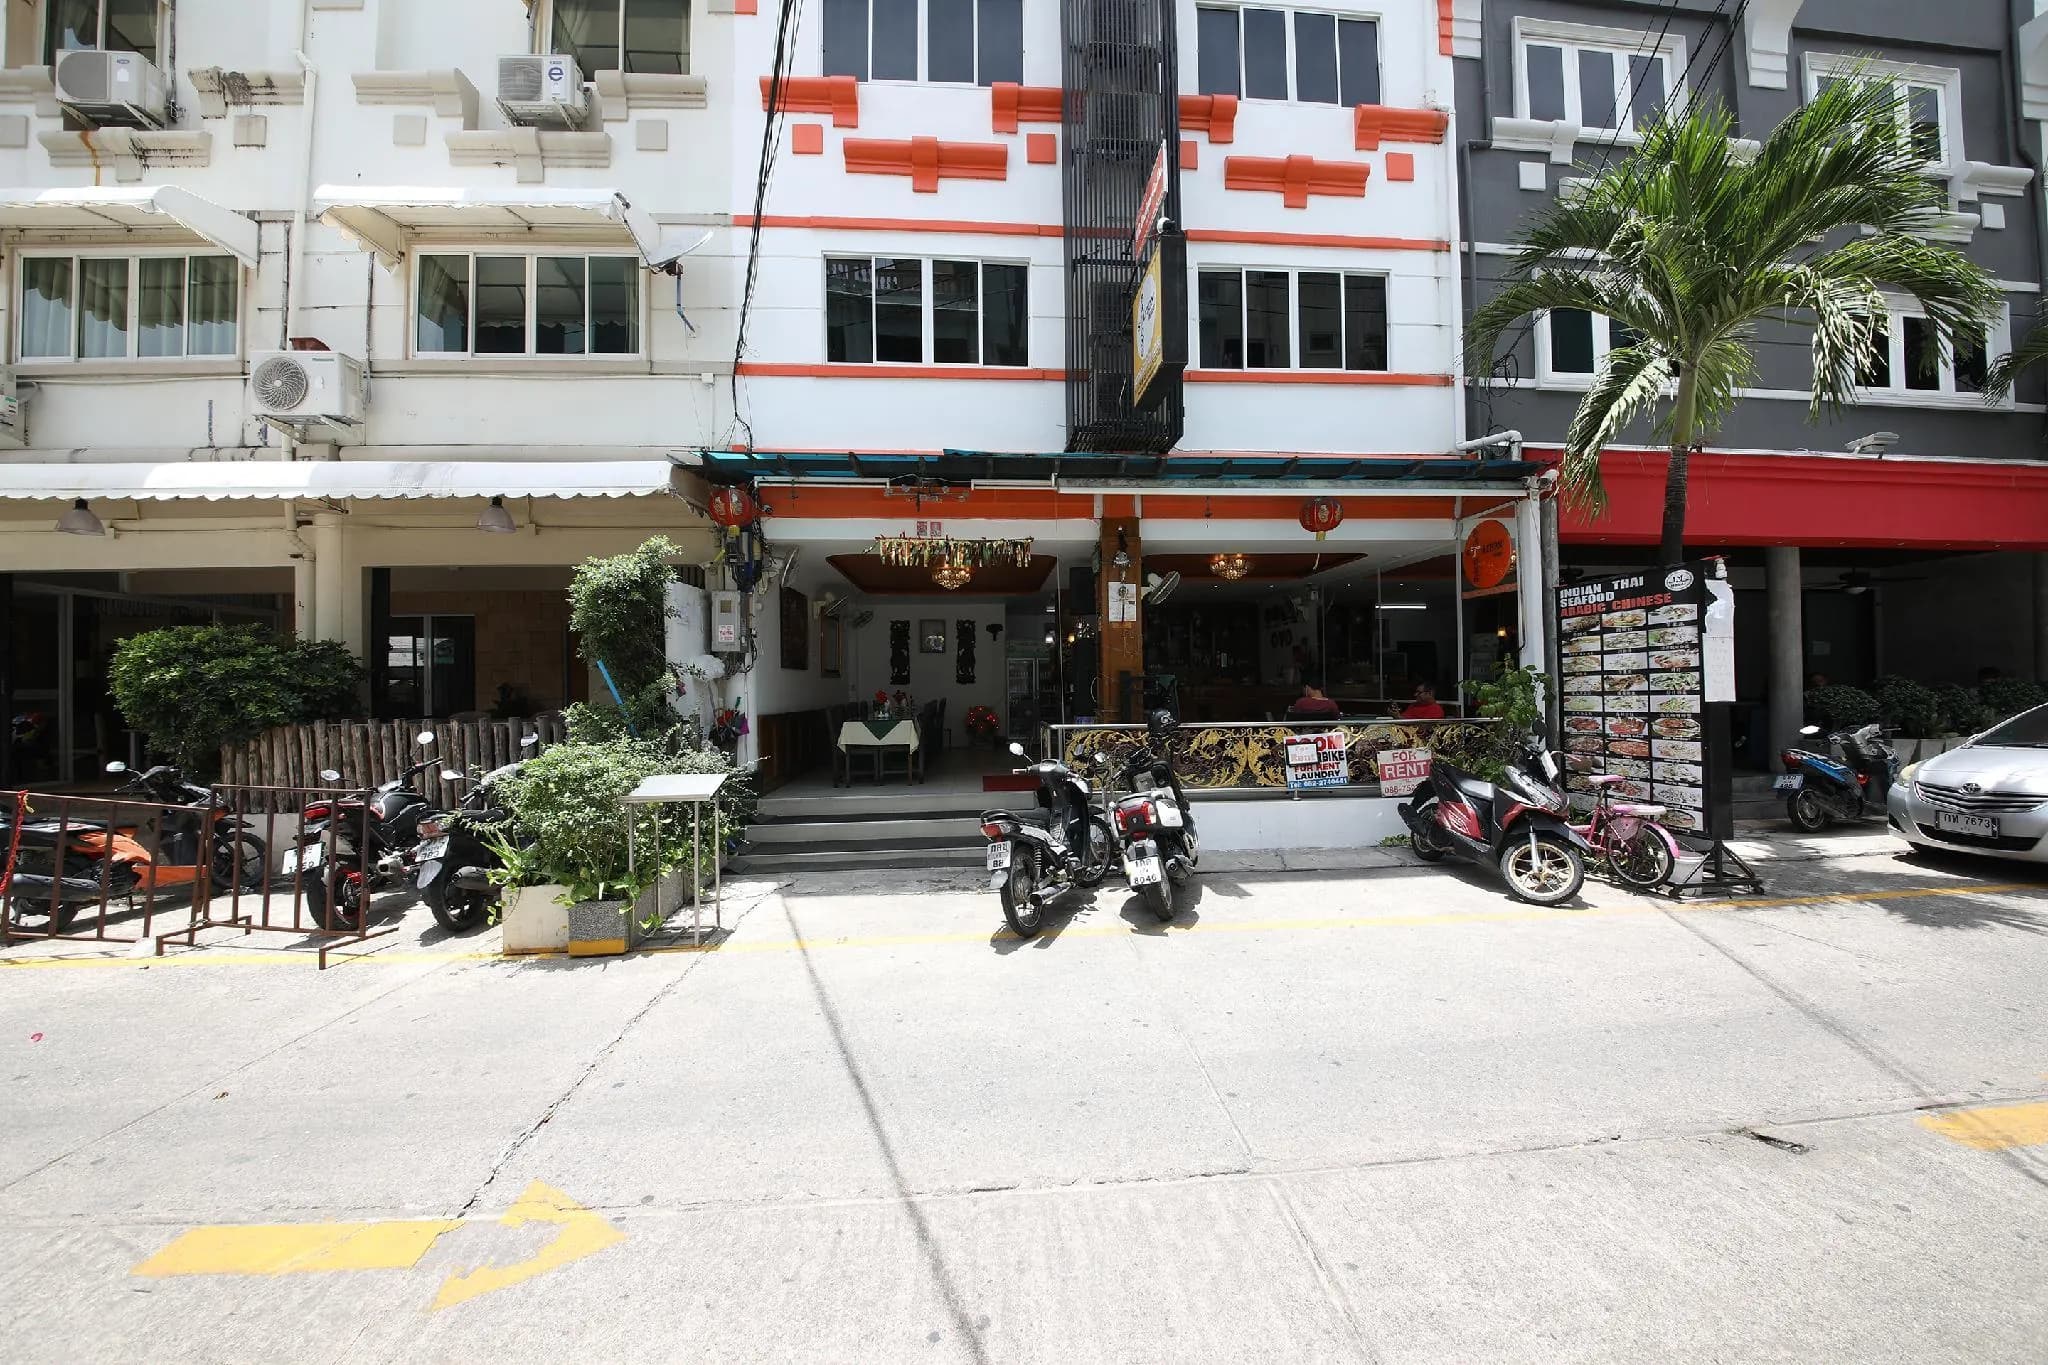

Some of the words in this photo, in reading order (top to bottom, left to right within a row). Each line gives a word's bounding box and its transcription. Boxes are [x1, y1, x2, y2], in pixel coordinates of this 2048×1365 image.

[1560, 583, 1602, 599] INDIAN
[1612, 576, 1644, 591] THAI
[1560, 592, 1615, 608] SEAFOOD
[1560, 602, 1606, 617] ARABIC
[1612, 593, 1672, 611] CHINESE
[1392, 751, 1417, 762] FOR
[1295, 763, 1313, 772] FOR
[1316, 762, 1341, 771] RENT
[1385, 761, 1427, 778] RENT
[1295, 770, 1341, 780] LAUNDRY
[1964, 816, 1991, 828] 7673
